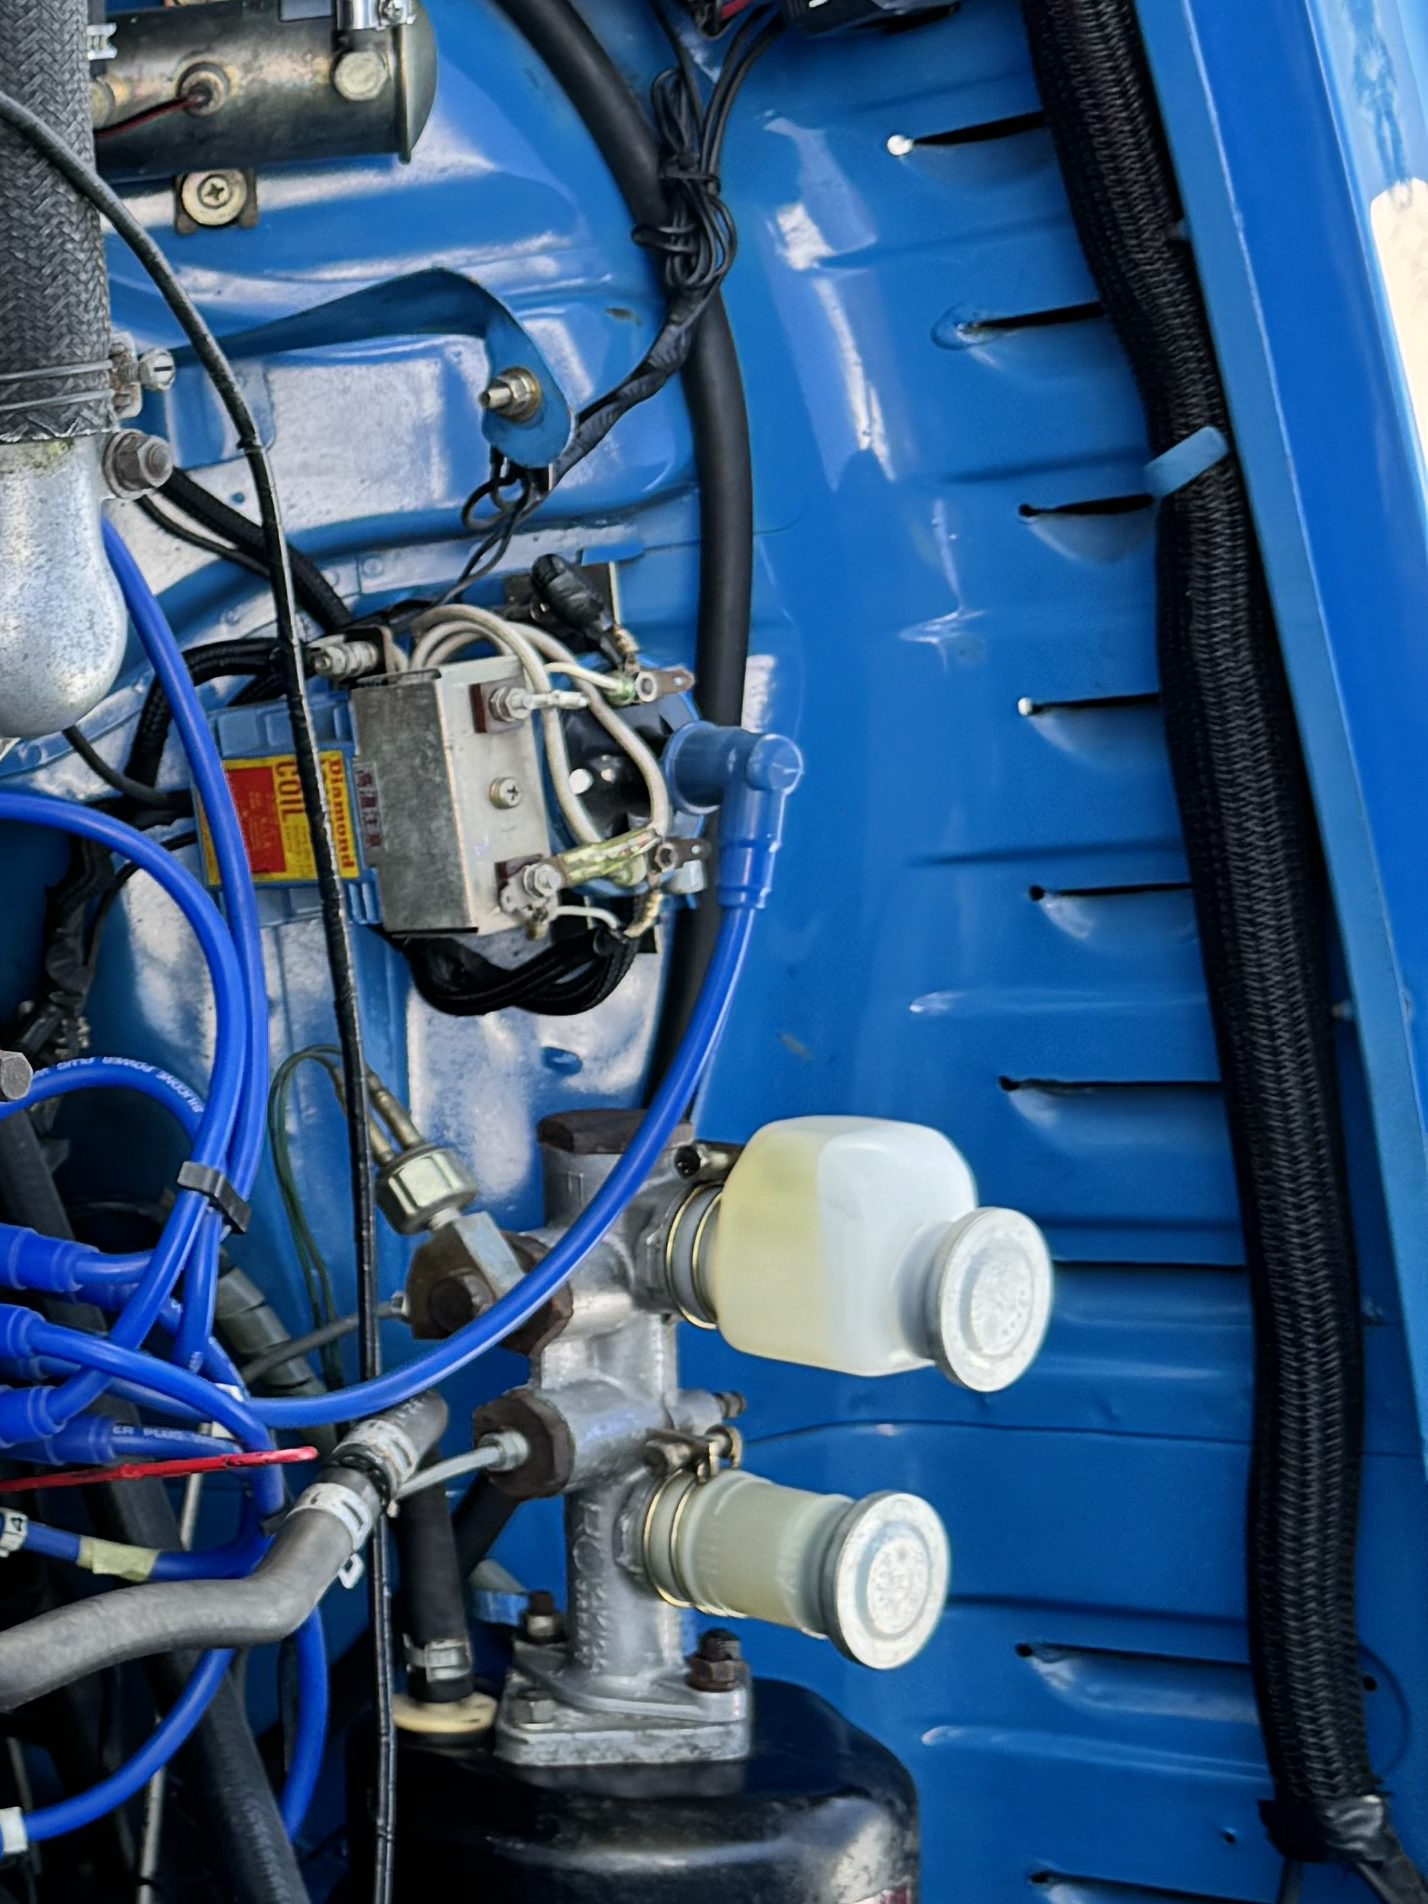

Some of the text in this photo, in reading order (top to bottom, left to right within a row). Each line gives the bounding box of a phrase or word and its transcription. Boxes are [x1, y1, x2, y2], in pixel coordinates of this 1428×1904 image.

[275, 760, 306, 824] COIL
[328, 758, 356, 870] Diamond
[101, 1056, 156, 1073] POWER
